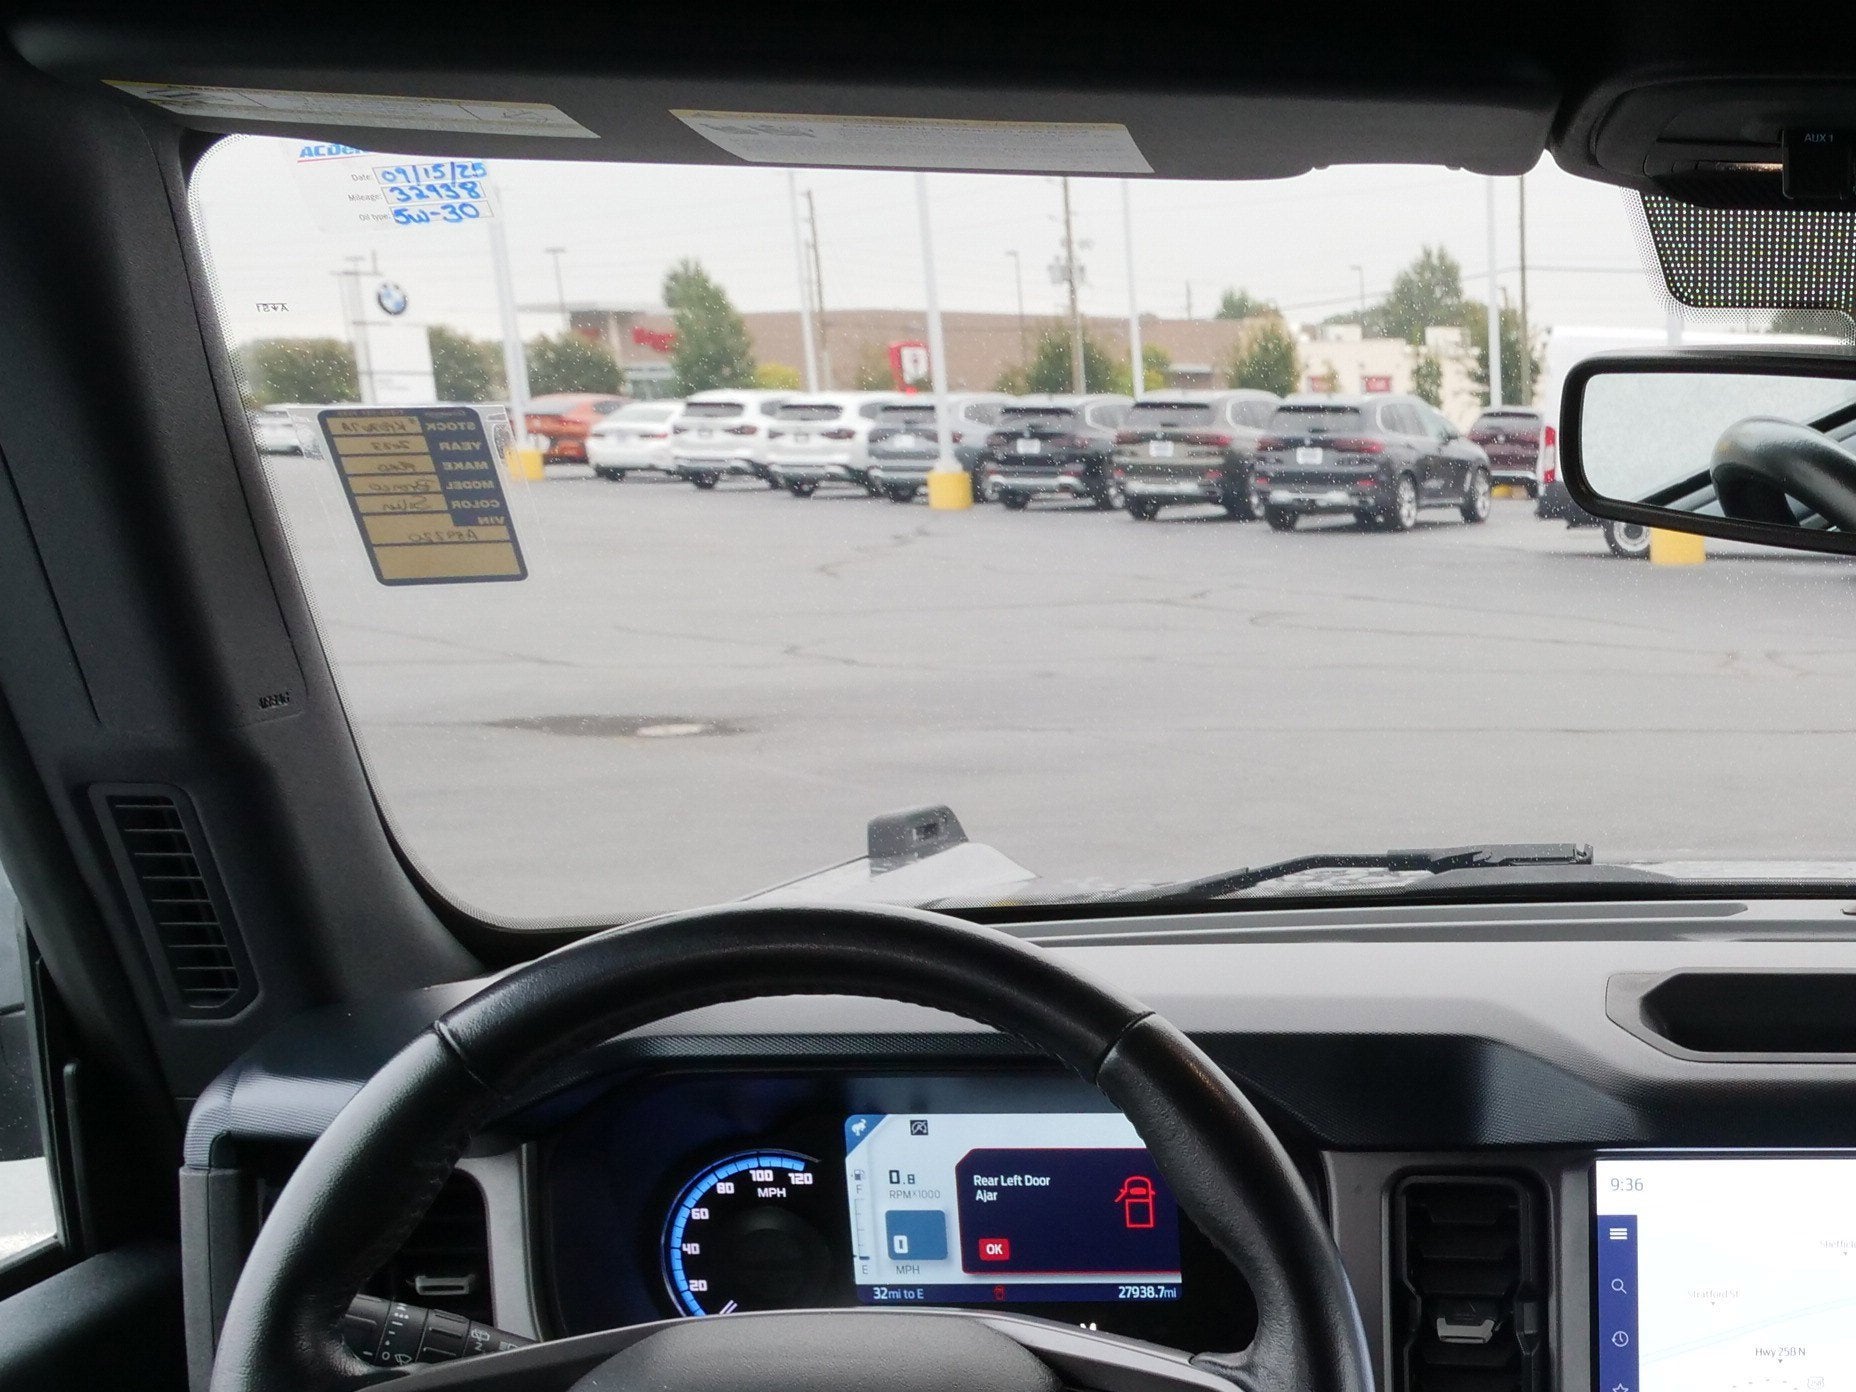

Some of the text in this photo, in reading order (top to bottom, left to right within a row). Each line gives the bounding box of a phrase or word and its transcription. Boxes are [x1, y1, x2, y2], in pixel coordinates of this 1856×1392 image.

[1804, 133, 1826, 142] AUX
[381, 161, 487, 186] 09/15/25
[389, 181, 481, 202] 32938
[749, 1169, 774, 1182] 100
[788, 1172, 814, 1185] 120
[974, 1174, 1051, 1187] Rear Left Door
[716, 1182, 735, 1194] 80
[856, 1185, 863, 1194] F
[1610, 1177, 1644, 1192] 9:36
[757, 1187, 787, 1198] MPH
[975, 1190, 998, 1203] Ajar
[691, 1208, 709, 1220] 60
[682, 1243, 700, 1255] 40
[986, 1244, 1003, 1255] OK
[862, 1265, 868, 1275] E
[896, 1265, 920, 1275] MPH
[689, 1280, 708, 1292] 20
[903, 1288, 915, 1300] to
[916, 1288, 924, 1300] E
[1755, 1347, 1806, 1359] Hwy 258 N
